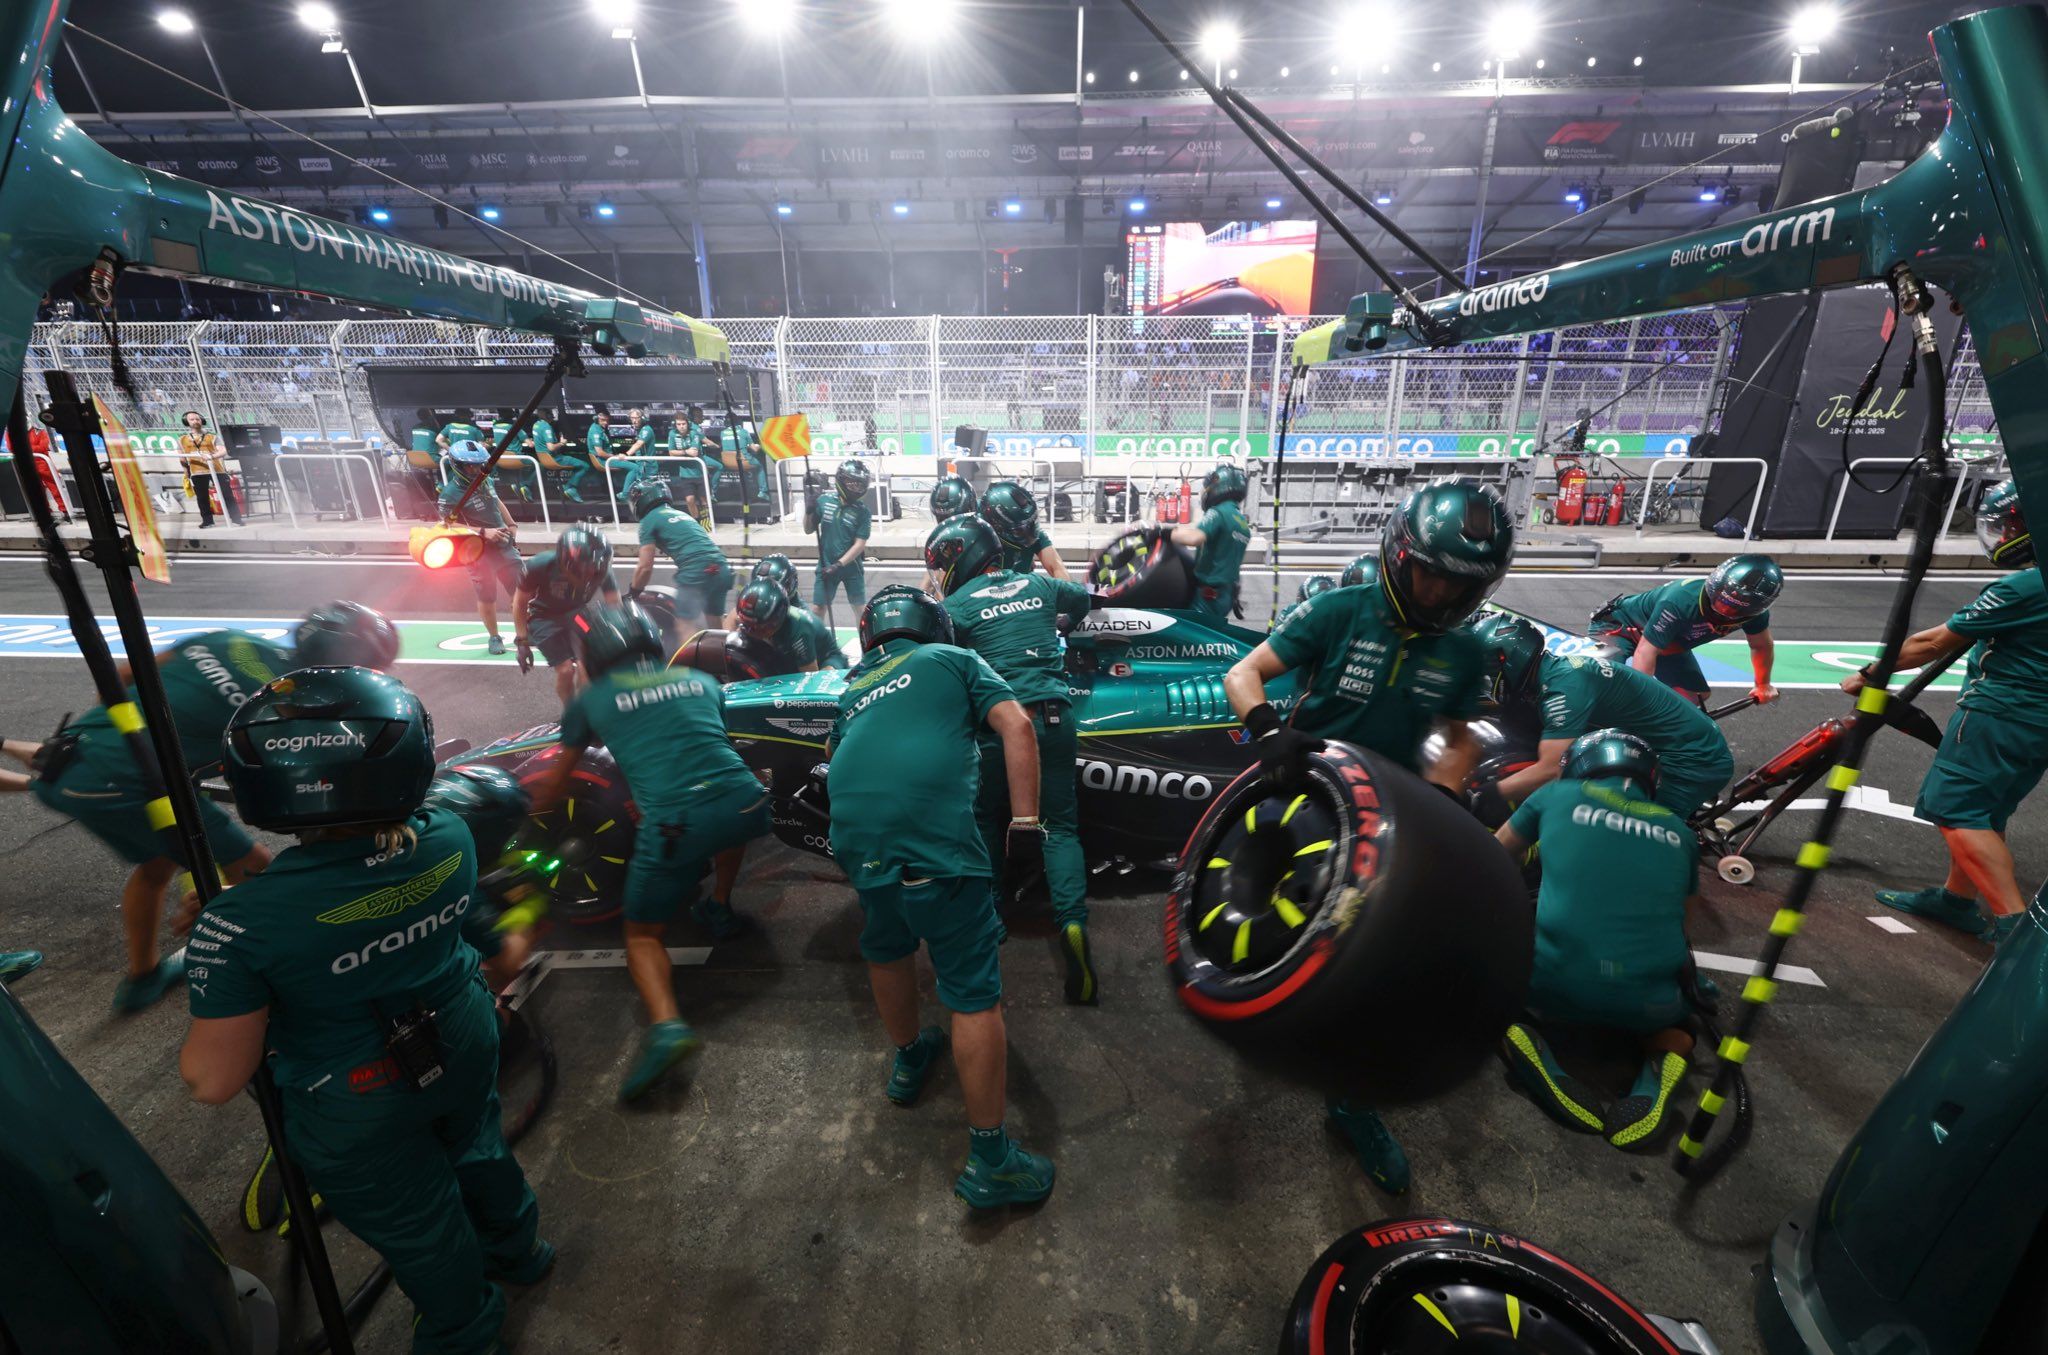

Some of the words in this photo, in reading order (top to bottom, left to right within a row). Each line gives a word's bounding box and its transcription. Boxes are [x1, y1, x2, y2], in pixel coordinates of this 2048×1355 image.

[1187, 141, 1222, 151] QATAR
[1641, 132, 1695, 147] LVMH
[255, 156, 279, 166] aws
[481, 153, 507, 164] MSC
[821, 148, 869, 162] LVMH
[946, 149, 990, 159] aramco
[197, 161, 238, 170] aramco
[302, 159, 329, 169] Lenovo
[1670, 243, 1707, 267] Built
[1710, 241, 1731, 258] on
[1741, 205, 1835, 256] arm
[207, 190, 345, 261] ASTON
[354, 233, 461, 287] MARTIN
[464, 262, 559, 308] aramco
[1460, 273, 1550, 316] aramco
[651, 315, 673, 334] arm
[1116, 438, 1250, 458] aramco
[1295, 437, 1434, 458] aramco
[980, 597, 1043, 620] aramco
[1125, 645, 1177, 659] ASTON
[1181, 643, 1239, 657] MARTIN
[183, 644, 247, 706] aramco
[1345, 663, 1375, 679] BOSS
[615, 679, 704, 712] aramco
[1068, 687, 1091, 696] One
[787, 699, 839, 709] pepperstone
[265, 732, 366, 751] cognizant
[296, 780, 334, 794] Stilo
[1572, 803, 1680, 848] aramco
[366, 890, 400, 910] ASTON
[400, 876, 436, 896] MARTIN
[201, 925, 233, 943] NetApp
[332, 895, 470, 975] aramco
[187, 966, 209, 980] citi
[1362, 1219, 1461, 1248] PIRELLI
